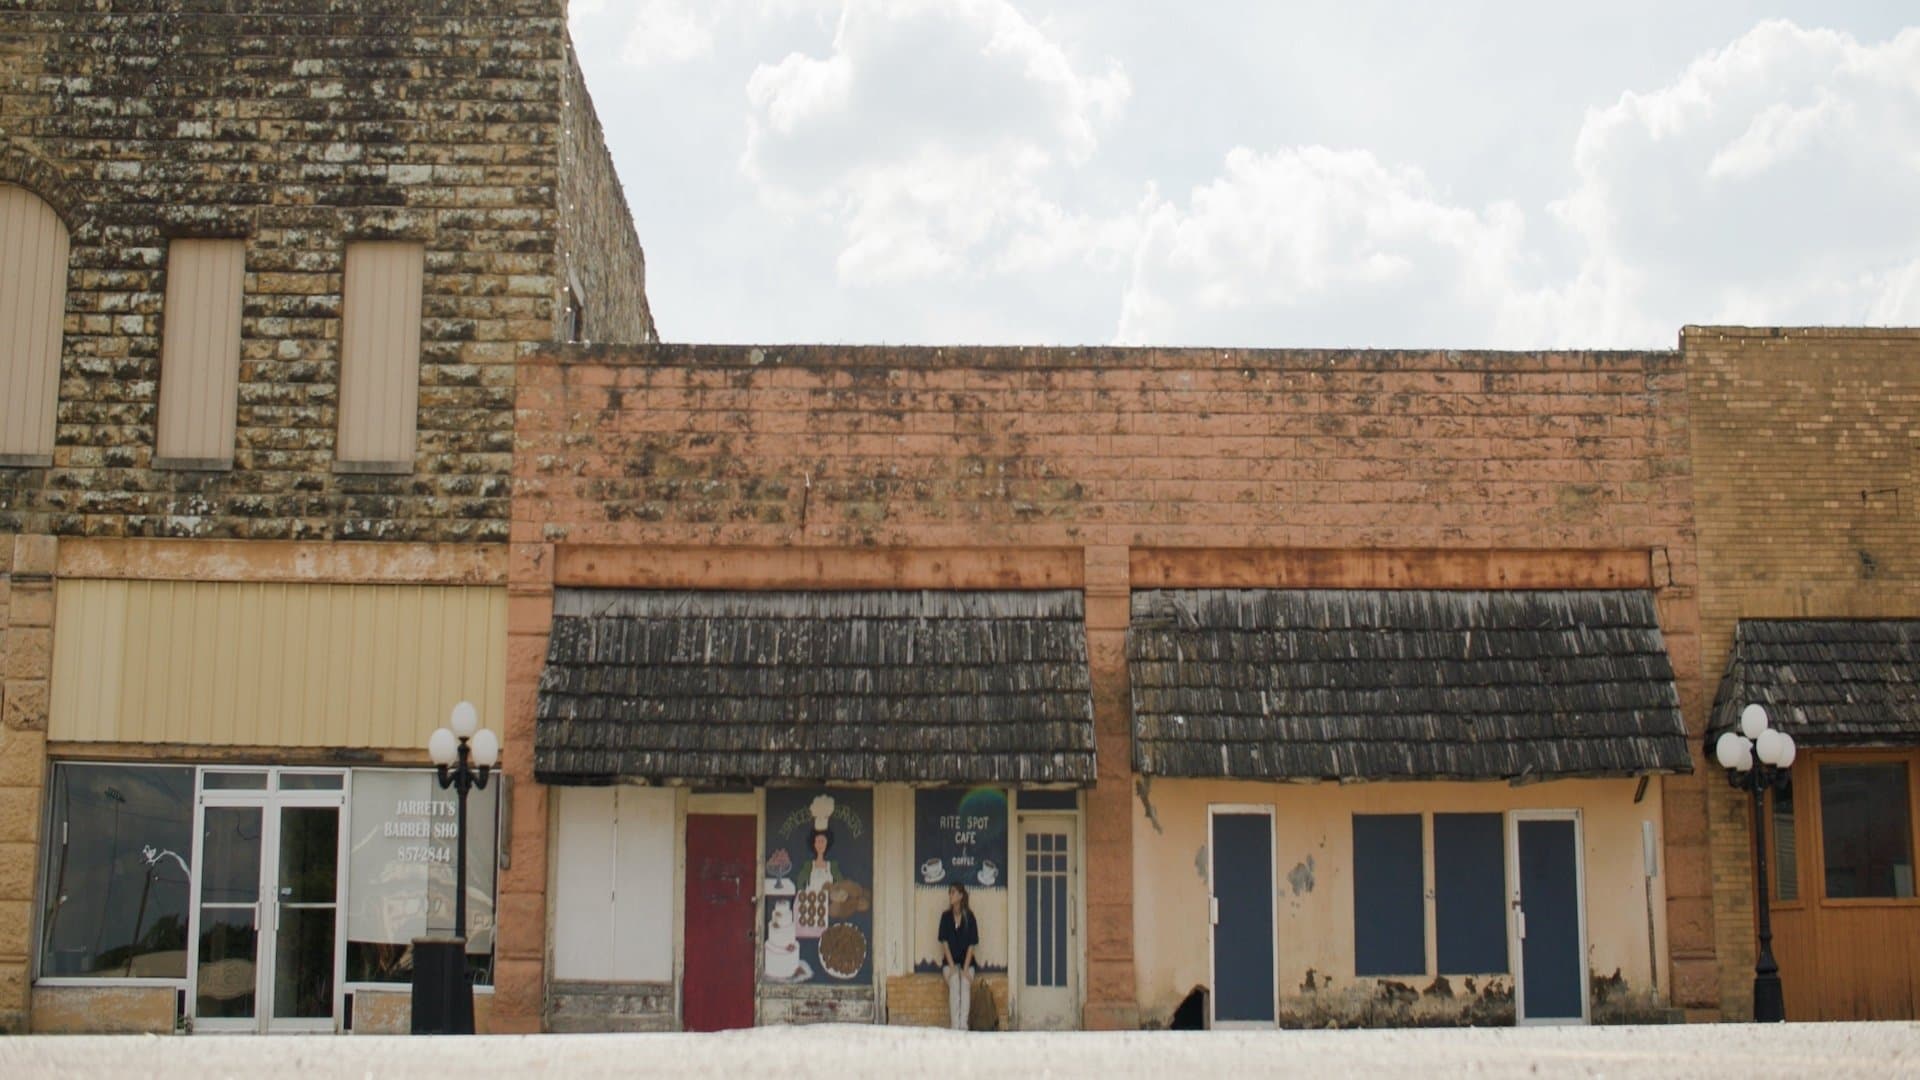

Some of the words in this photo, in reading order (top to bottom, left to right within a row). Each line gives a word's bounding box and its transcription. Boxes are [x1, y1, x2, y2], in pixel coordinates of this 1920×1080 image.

[396, 800, 455, 816] JARRETT'S
[384, 822, 430, 837] BARBER
[433, 822, 458, 838] SHO
[940, 816, 960, 829] RITE
[967, 816, 989, 830] SPOT
[955, 831, 976, 844] CAFE
